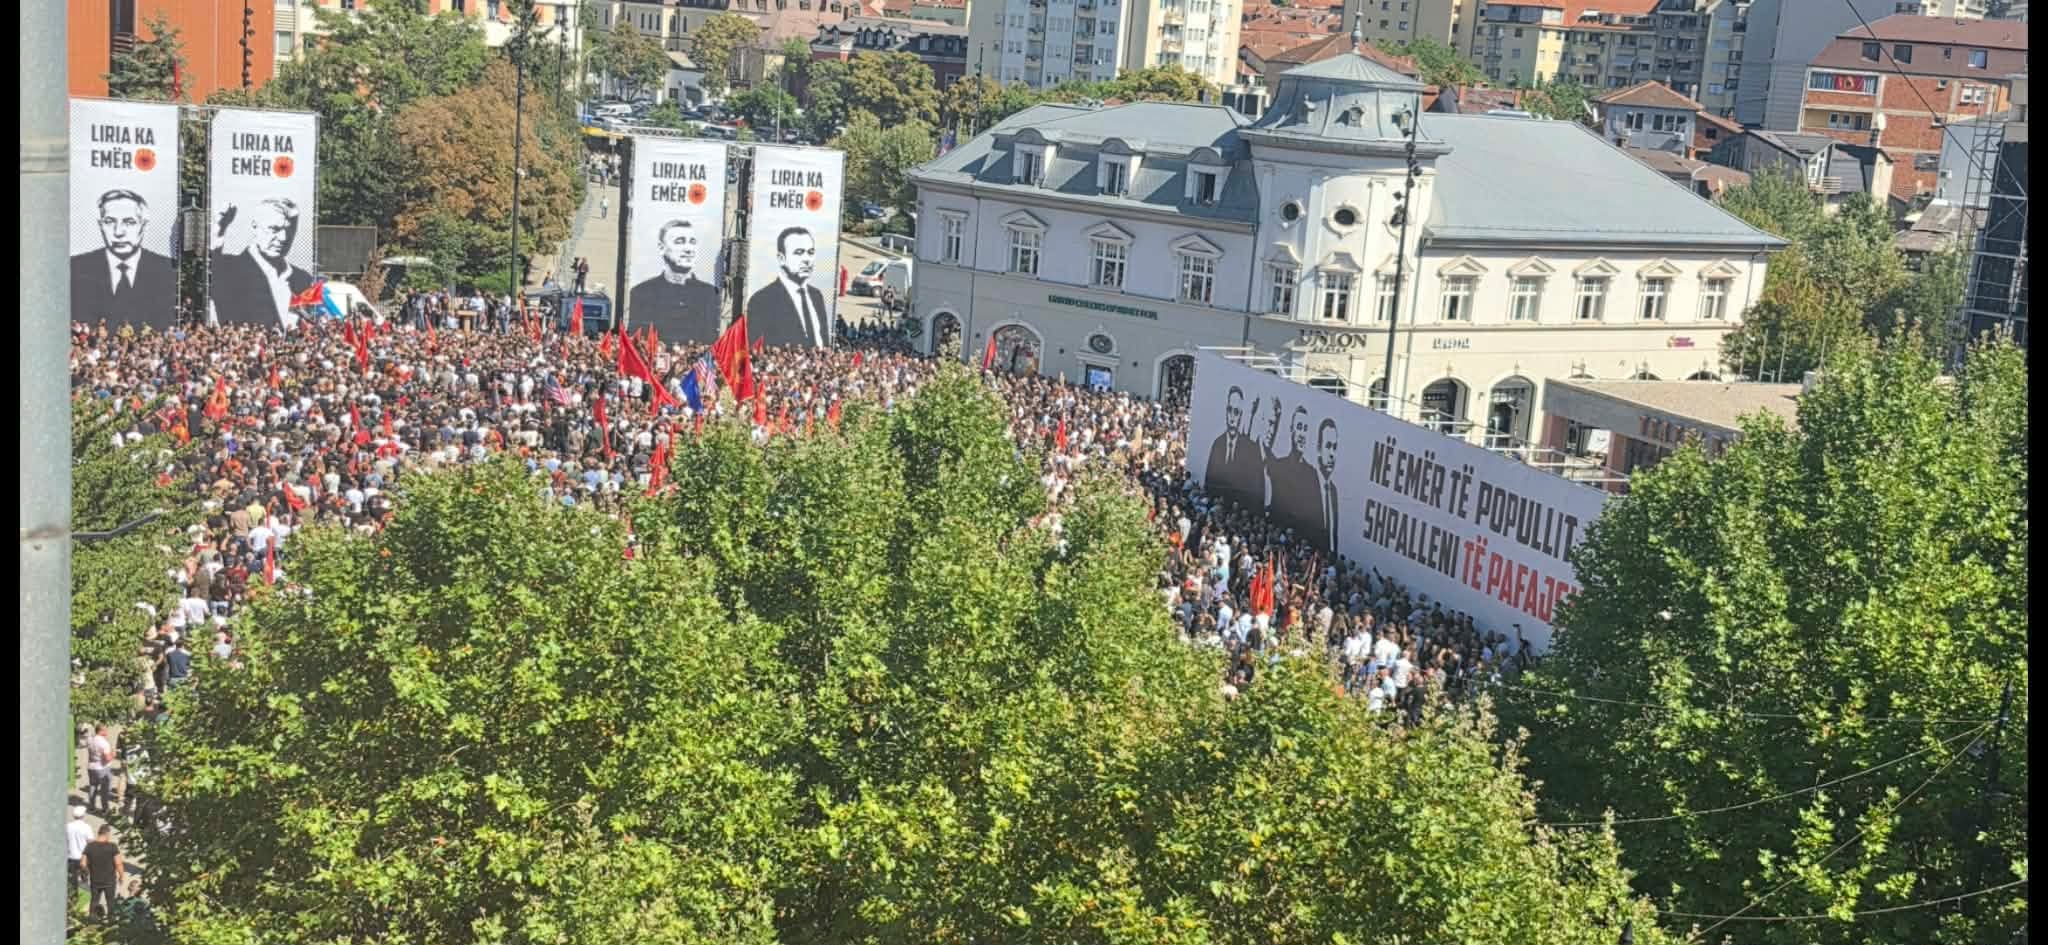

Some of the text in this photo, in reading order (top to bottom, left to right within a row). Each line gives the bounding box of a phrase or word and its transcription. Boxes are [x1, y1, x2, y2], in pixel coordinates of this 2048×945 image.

[91, 123, 154, 146] LIRIA KA
[232, 132, 294, 153] LIRIA KA
[91, 147, 132, 169] EMËR
[232, 154, 271, 177] EMËR
[652, 161, 707, 181] LIRIA KA
[771, 168, 823, 189] LIRIA KA
[651, 181, 687, 203] EMËR
[770, 189, 804, 210] EMËR
[1299, 328, 1368, 349] UNION
[1369, 435, 1578, 562] NË EMËR TË POPULLIT
[1362, 498, 1461, 579] SHPALLENI
[1462, 535, 1488, 591] TË
